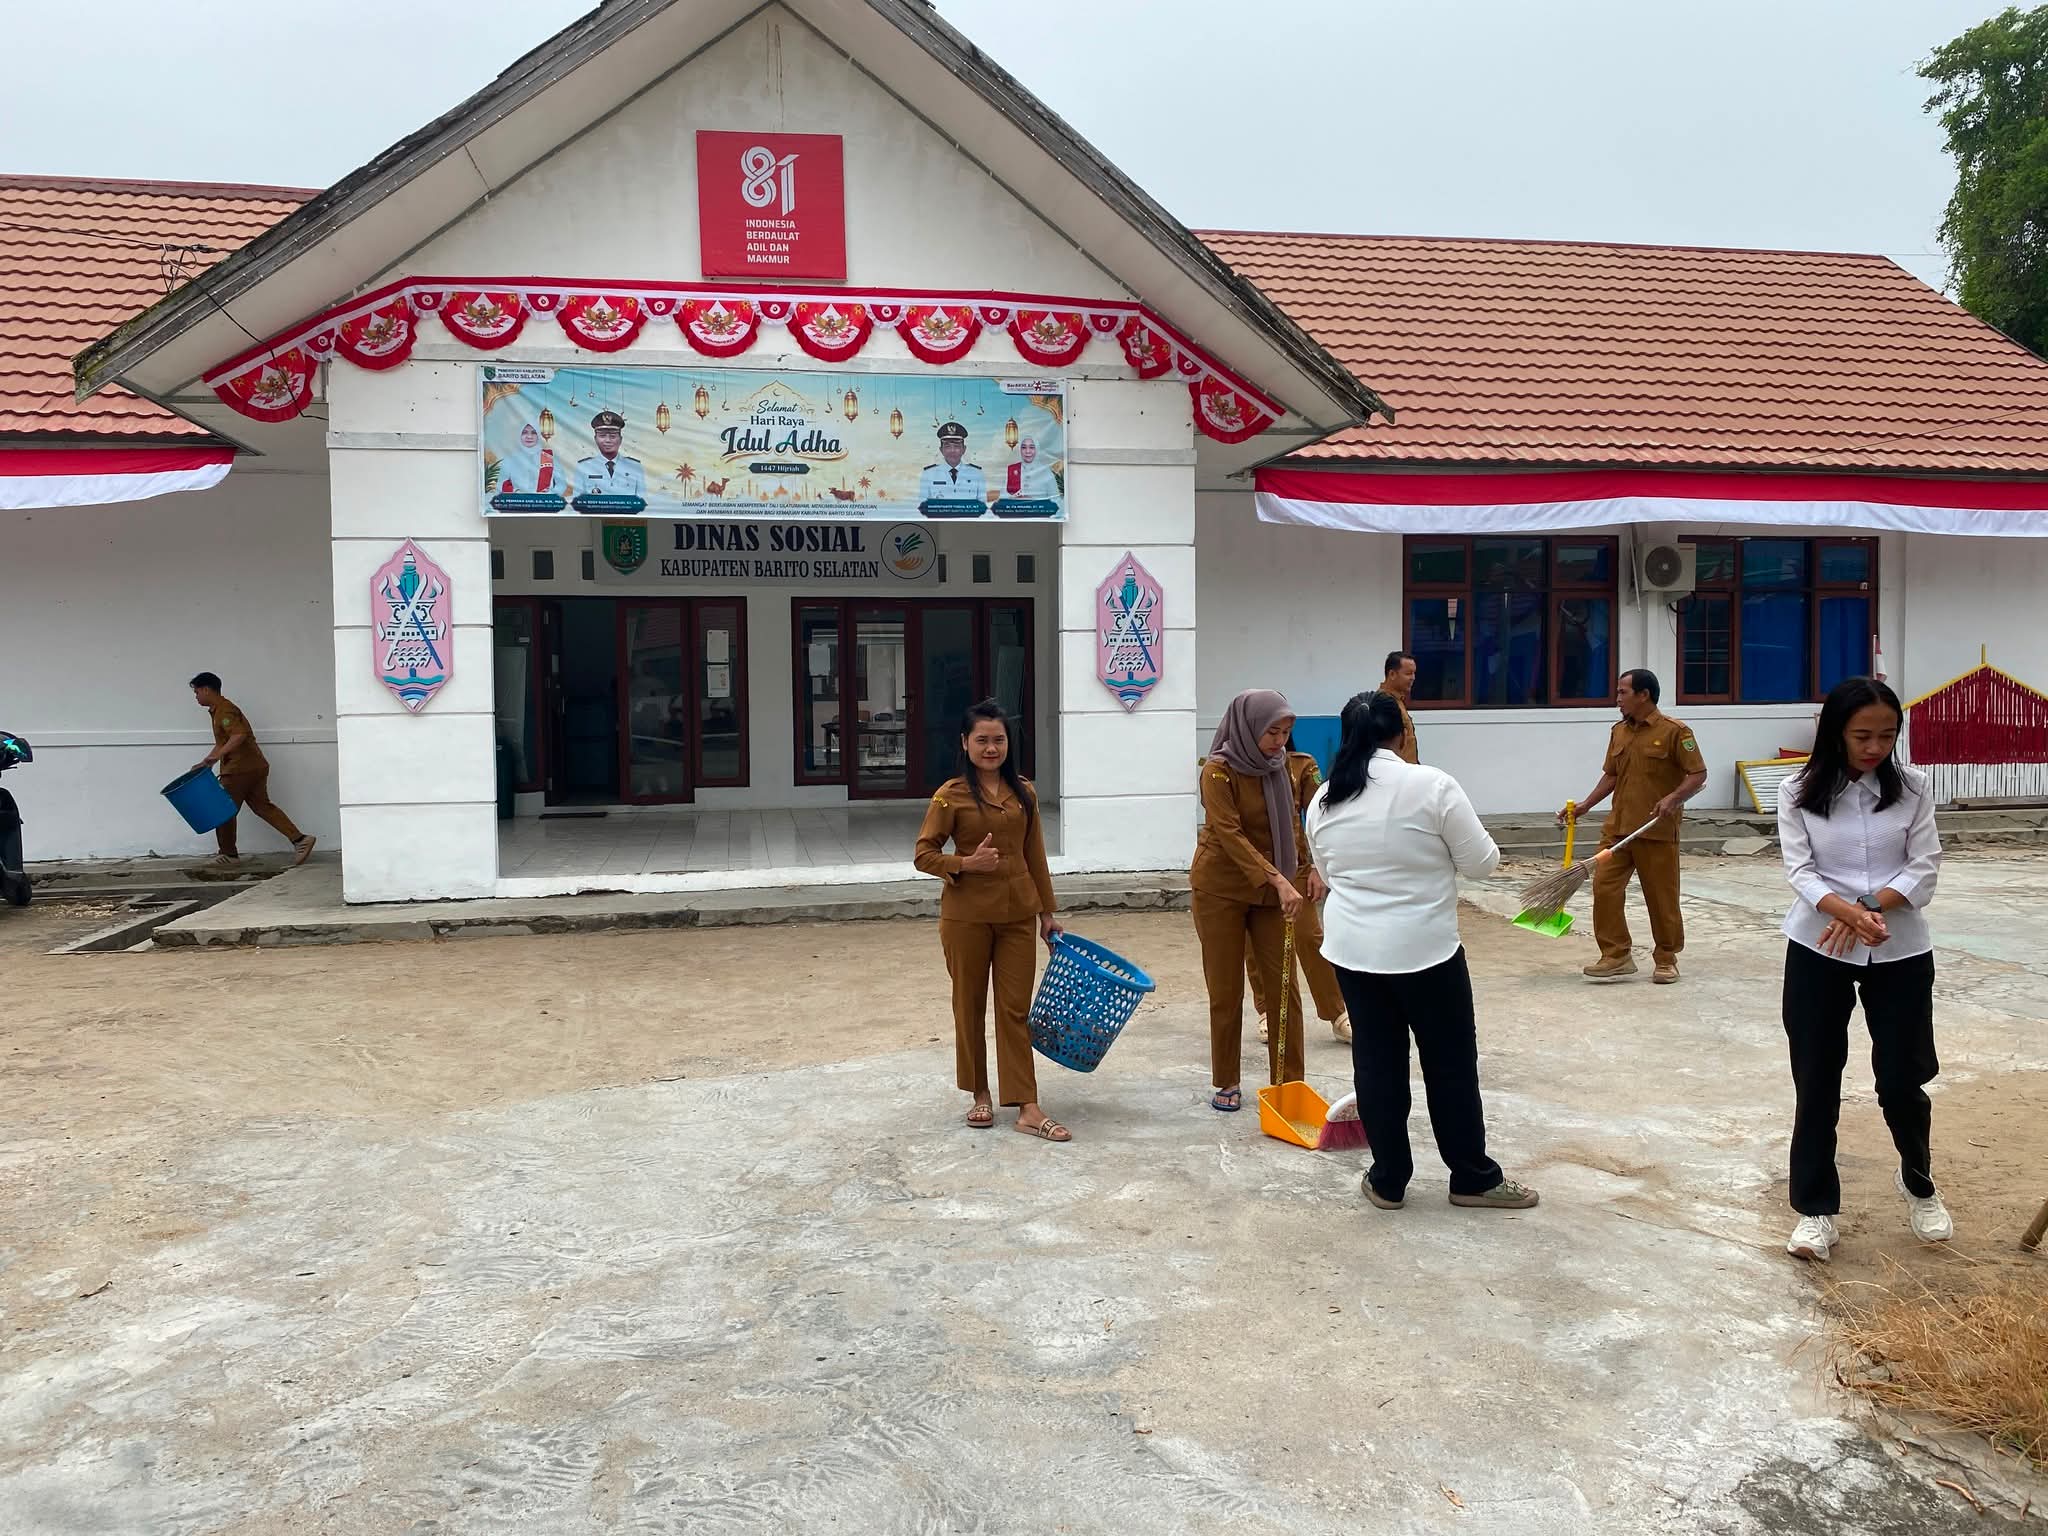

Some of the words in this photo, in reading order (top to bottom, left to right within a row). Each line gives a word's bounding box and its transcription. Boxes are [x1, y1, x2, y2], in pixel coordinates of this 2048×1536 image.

[740, 145, 800, 217] 81
[745, 219, 796, 229] INDONESIA
[746, 231, 800, 241] BERDAULAT
[746, 242, 768, 252] ADIL
[769, 243, 789, 252] DAN
[747, 254, 790, 264] MAKMUR
[756, 399, 798, 414] Selamat
[750, 415, 775, 426] Hari
[778, 416, 805, 428] Raya
[720, 426, 772, 457] Idul
[775, 429, 842, 454] Adha
[777, 465, 800, 473] Hijriah
[673, 523, 760, 552] DINAS
[769, 524, 866, 553] SOSIAL
[660, 558, 751, 577] KABUPATEN
[754, 560, 809, 578] BARITO
[813, 560, 879, 578] SELATAN
